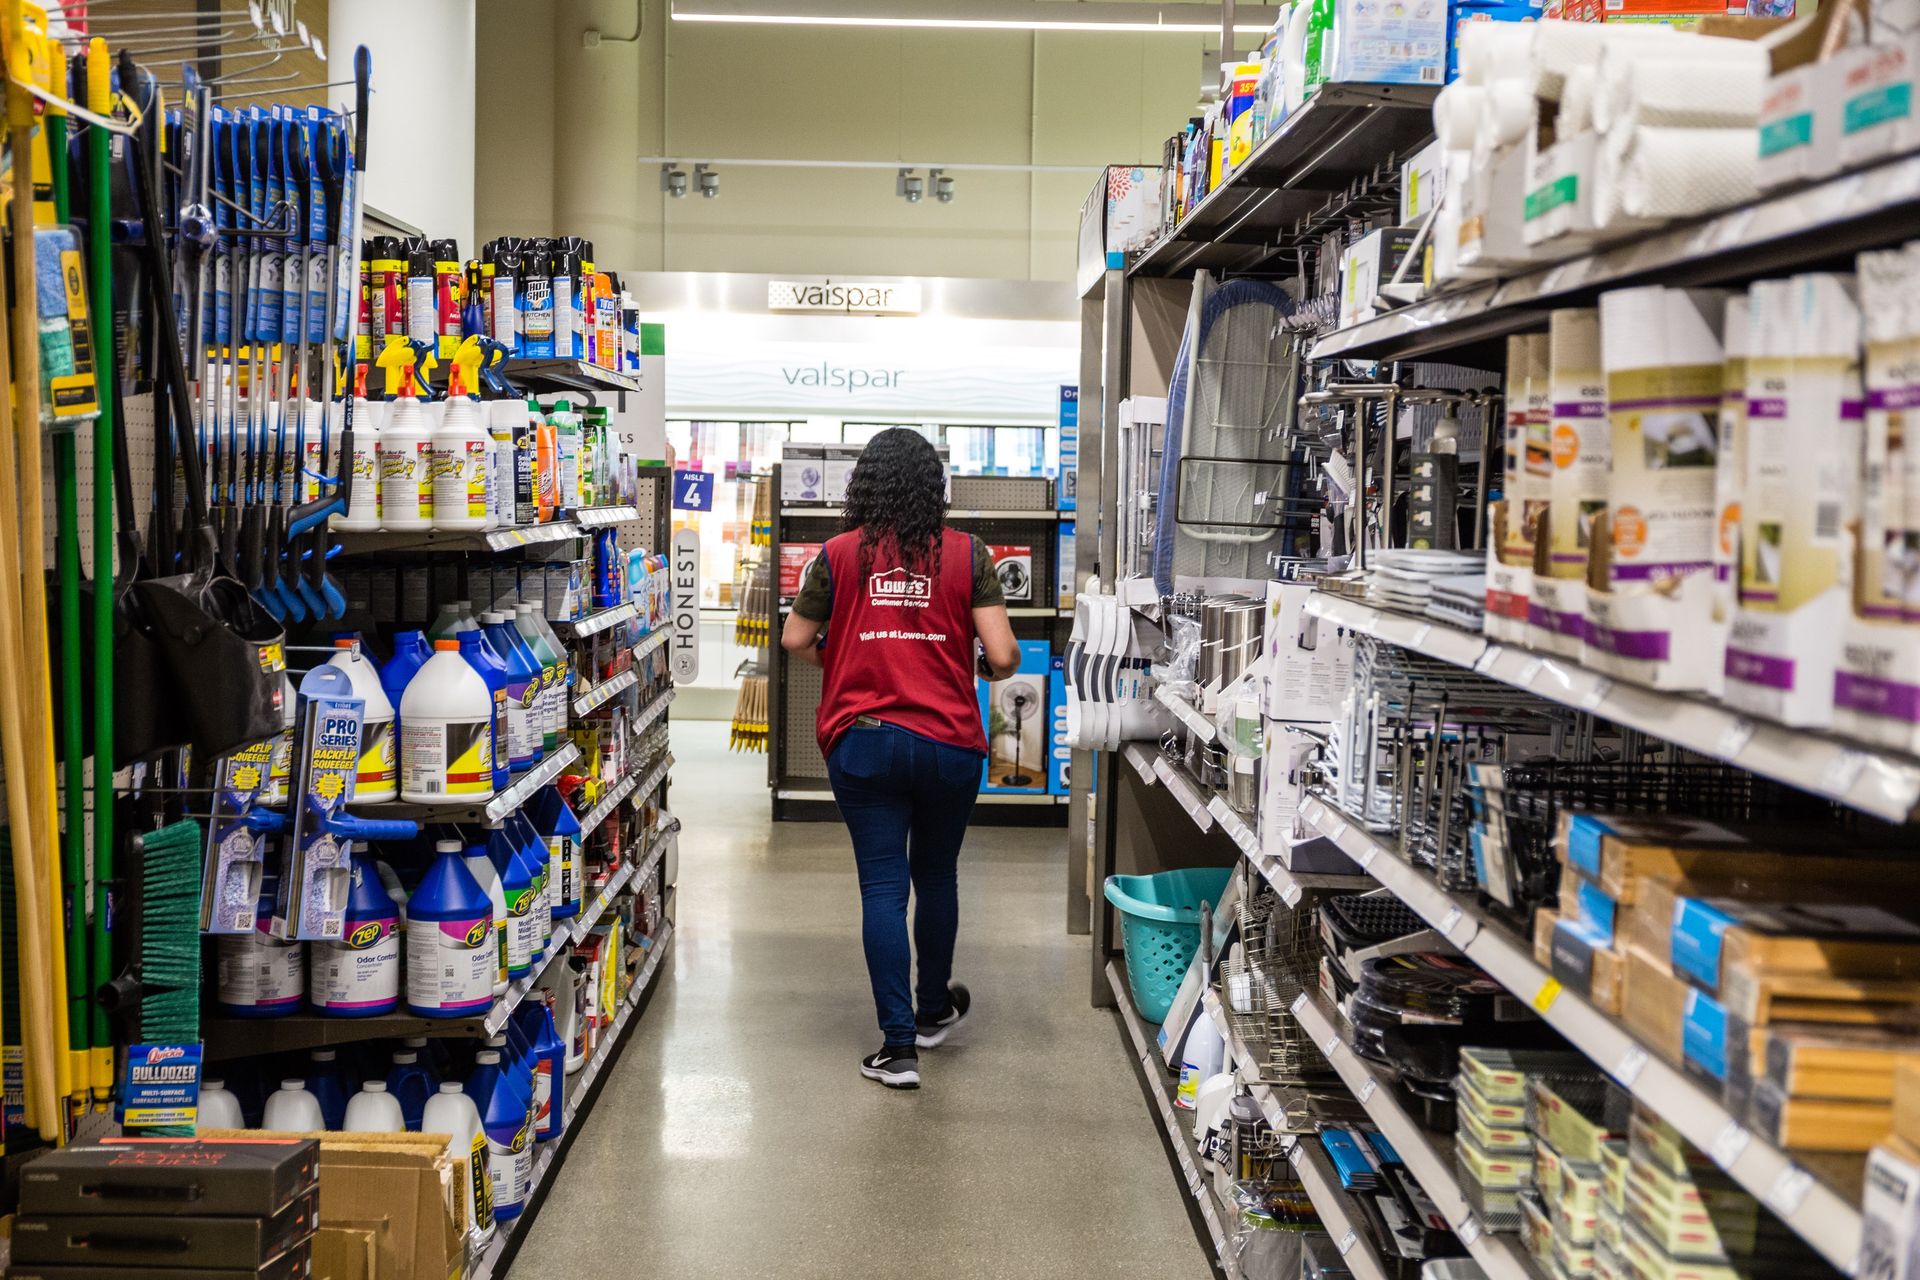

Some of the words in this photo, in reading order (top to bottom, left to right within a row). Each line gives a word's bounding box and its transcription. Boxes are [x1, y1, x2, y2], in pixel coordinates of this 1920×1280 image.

[529, 281, 548, 291] HOT
[527, 289, 550, 301] SHOT
[792, 278, 893, 313] valspar
[782, 361, 905, 393] valspar
[683, 473, 704, 482] AISLE
[683, 483, 702, 508] 4
[676, 545, 695, 649] HONEST
[871, 598, 903, 607] Customer
[903, 599, 929, 608] Service
[859, 631, 876, 642] Visit
[876, 631, 888, 639] us
[889, 630, 898, 639] at
[898, 630, 946, 642] Lowes.com
[325, 718, 357, 735] PRO
[320, 734, 357, 747] SERIES
[313, 749, 356, 761] BACKFLIP
[313, 759, 355, 770] SQUEEGEE
[356, 956, 375, 964] Odor
[147, 1047, 184, 1065] Quickie
[132, 1065, 196, 1081] BULLDOZER
[141, 1089, 185, 1097] MULTI-SURFACE
